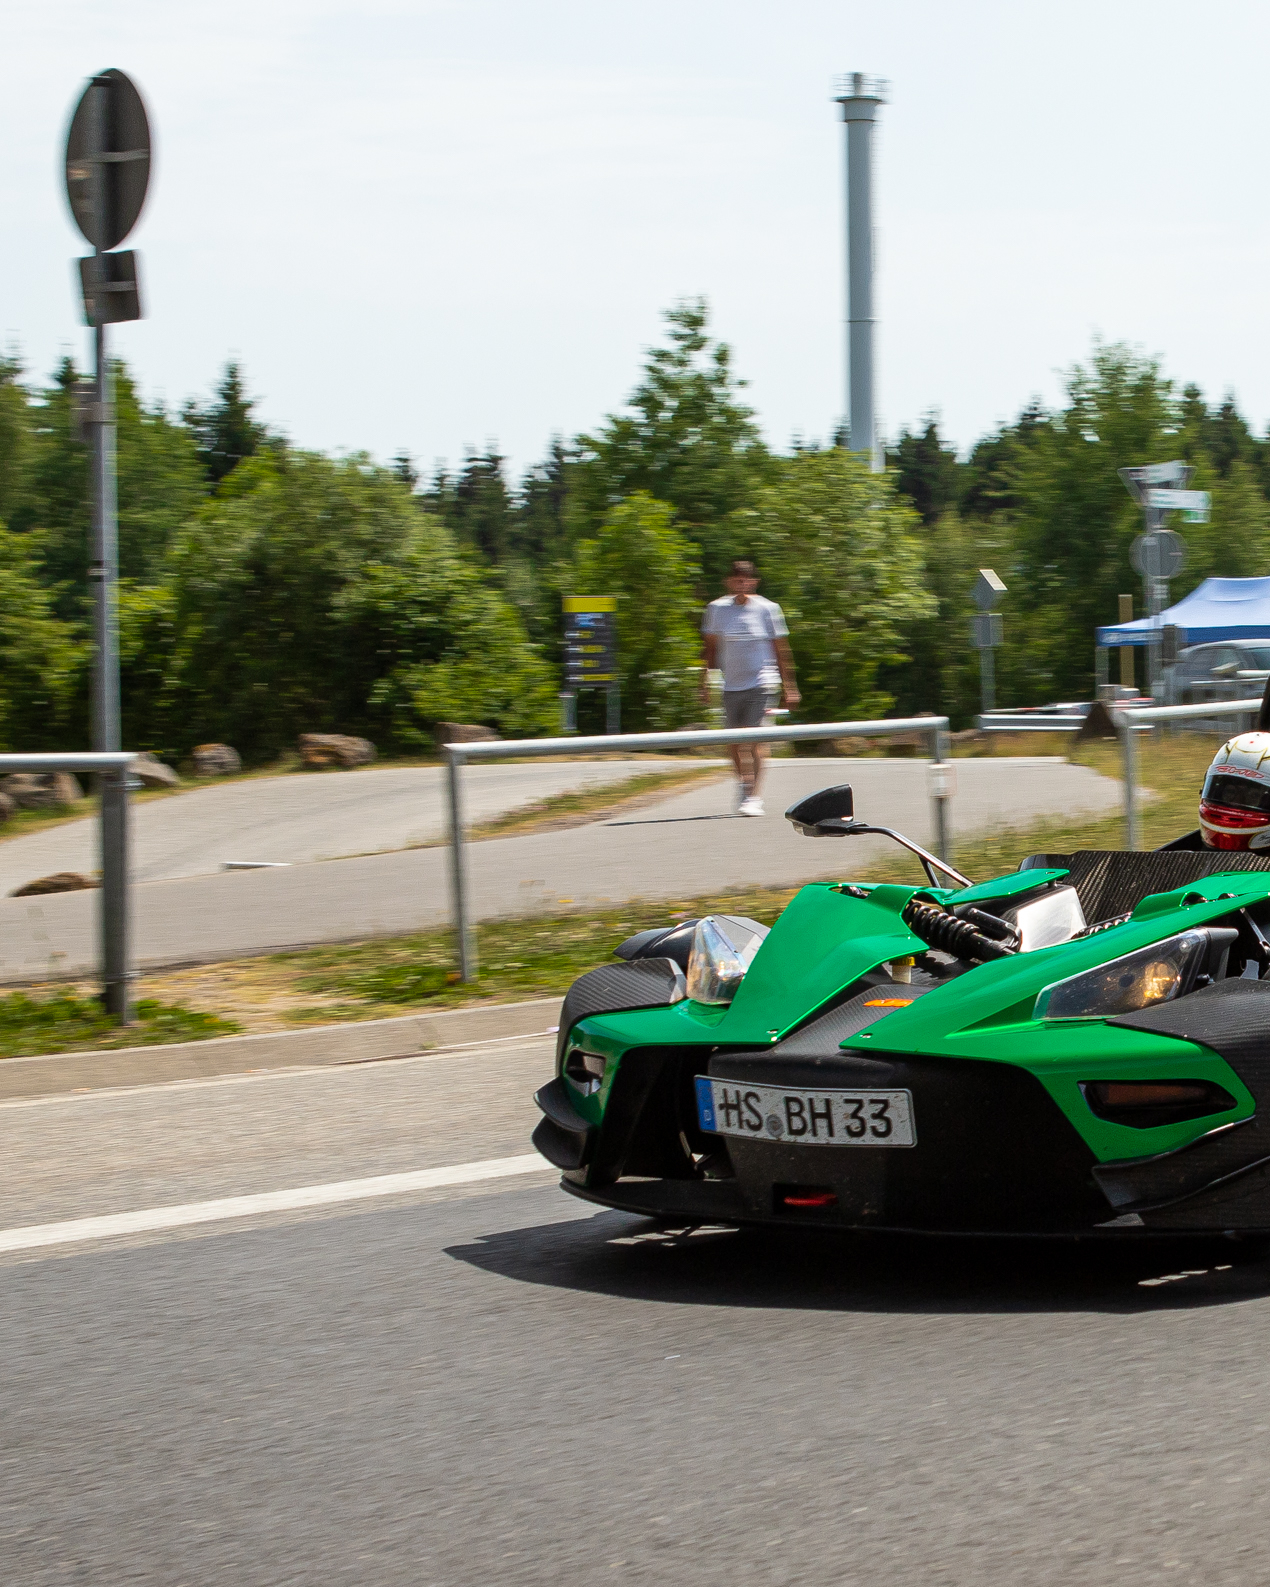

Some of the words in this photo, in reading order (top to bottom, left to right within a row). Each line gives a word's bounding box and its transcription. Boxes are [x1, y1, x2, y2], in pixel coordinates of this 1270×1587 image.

[719, 1088, 763, 1131] HS
[784, 1096, 834, 1137] BH
[843, 1099, 892, 1137] 33
